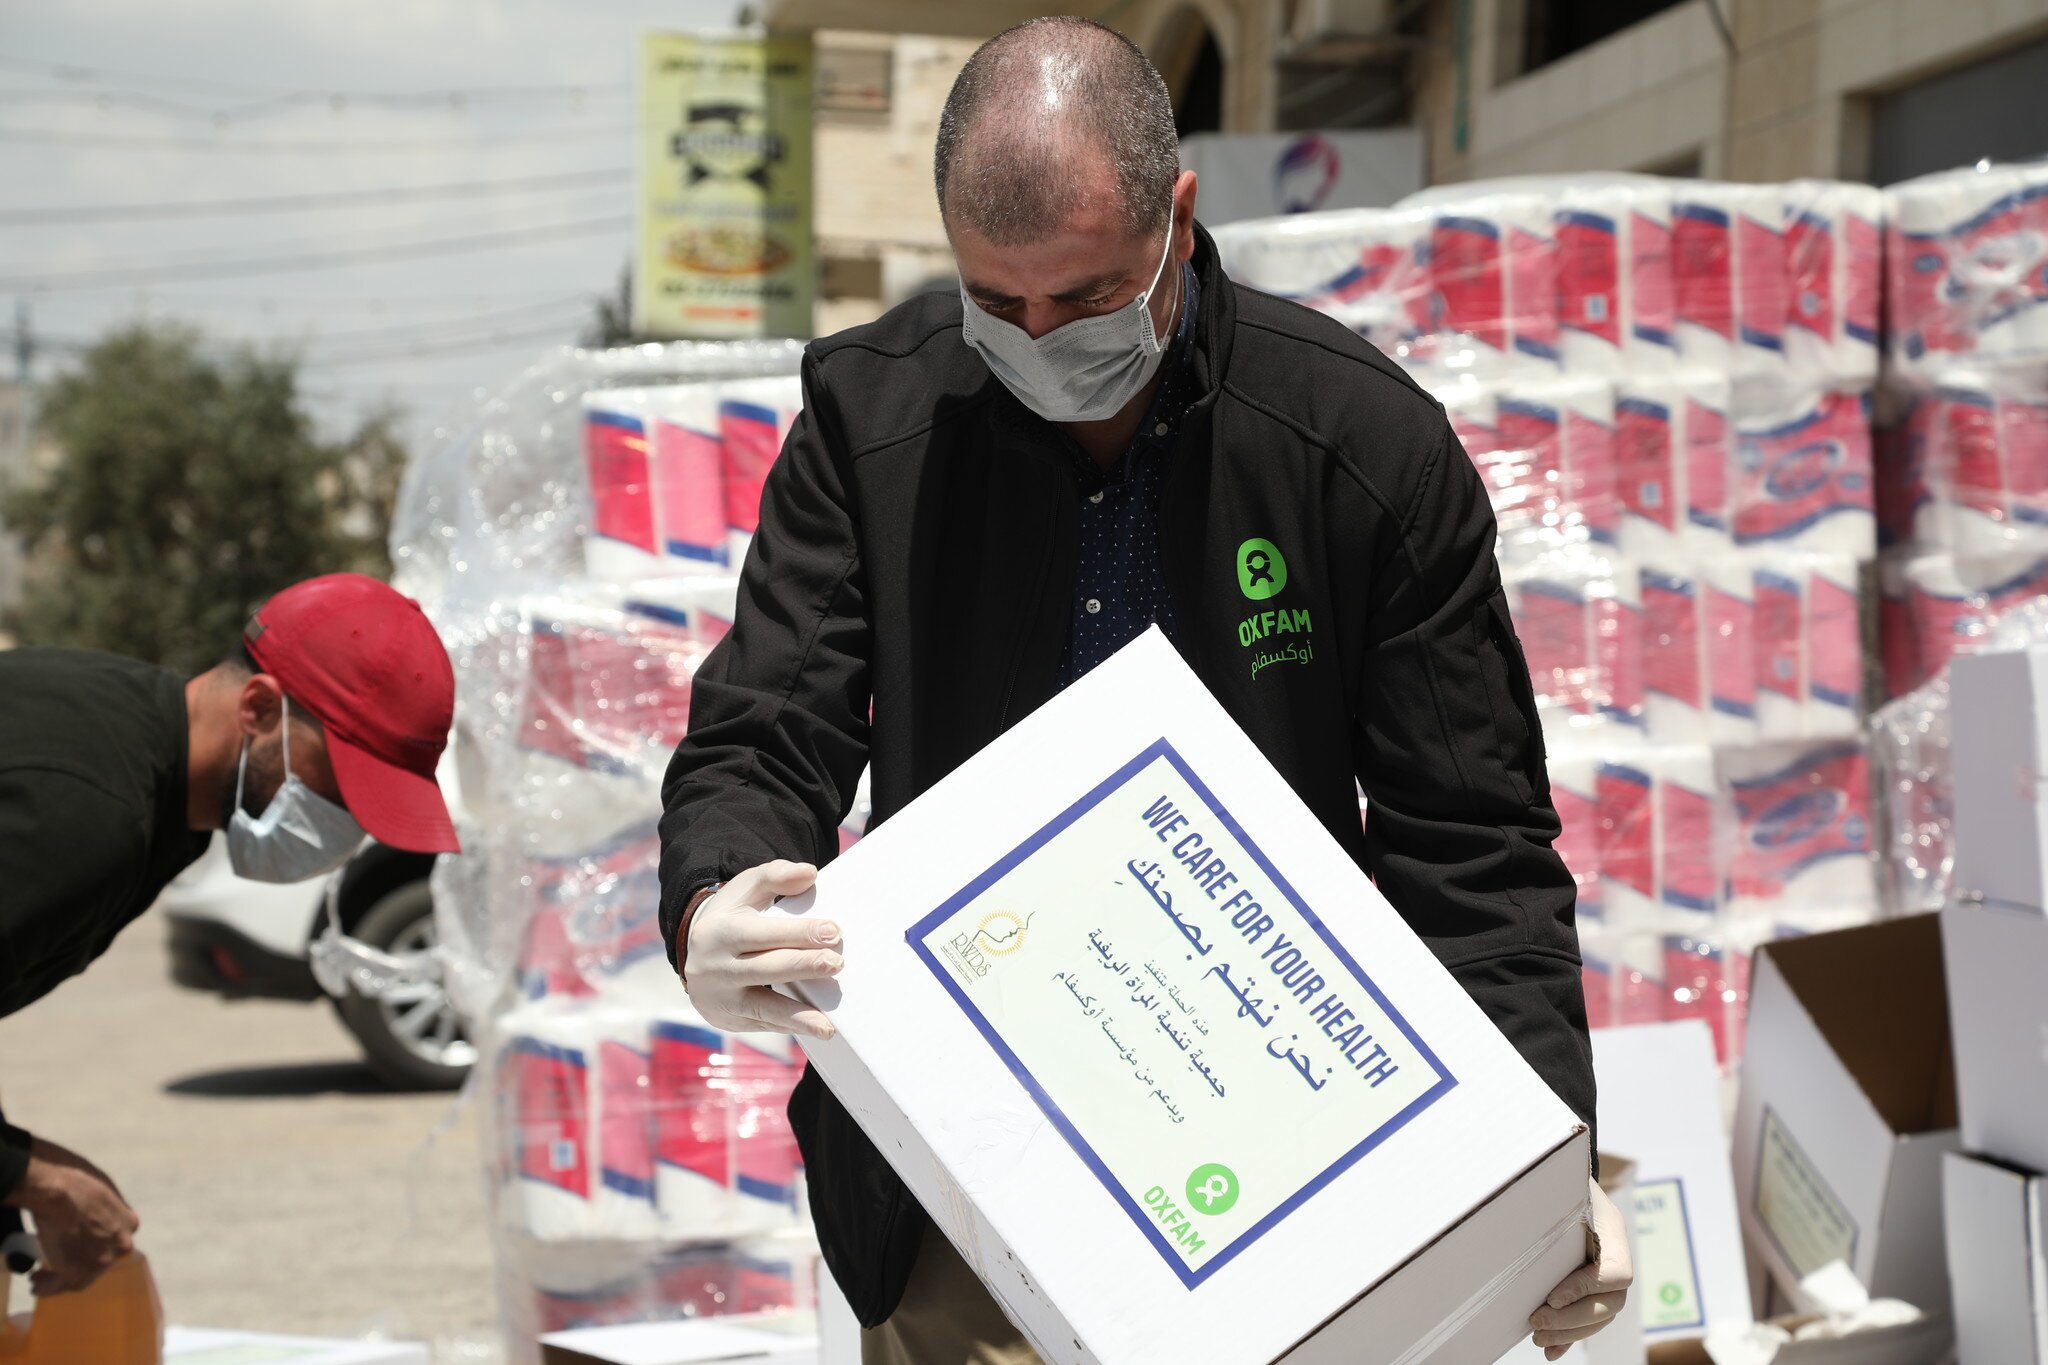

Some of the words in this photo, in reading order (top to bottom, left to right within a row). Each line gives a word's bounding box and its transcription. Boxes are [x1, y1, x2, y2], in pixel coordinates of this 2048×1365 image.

[1237, 608, 1313, 648] OXFAM
[1250, 640, 1314, 681] أوكسفام
[950, 932, 991, 977] RWDS
[1087, 928, 1131, 975] الريفية
[1141, 795, 1189, 843] WE
[1172, 833, 1238, 900] CARE
[1220, 889, 1274, 945] FOR
[1261, 933, 1325, 1005] YOUR
[1309, 994, 1399, 1088] HEALTH
[1052, 972, 1105, 1018] أوكسفام
[1126, 977, 1160, 1011] المرأة
[1144, 960, 1167, 988] بتنفيذ
[1201, 963, 1280, 1028] نهتم
[1168, 985, 1196, 1015] الحملة
[1102, 1017, 1137, 1065] مؤسسة
[1155, 1011, 1192, 1051] تنمية
[1192, 1019, 1208, 1036] هذه
[1135, 1069, 1154, 1085] من
[1188, 1049, 1225, 1098] جمعية
[1266, 1034, 1332, 1091] نحن
[1149, 1089, 1184, 1123] وبدعم
[1144, 1186, 1206, 1255] OXFAM
